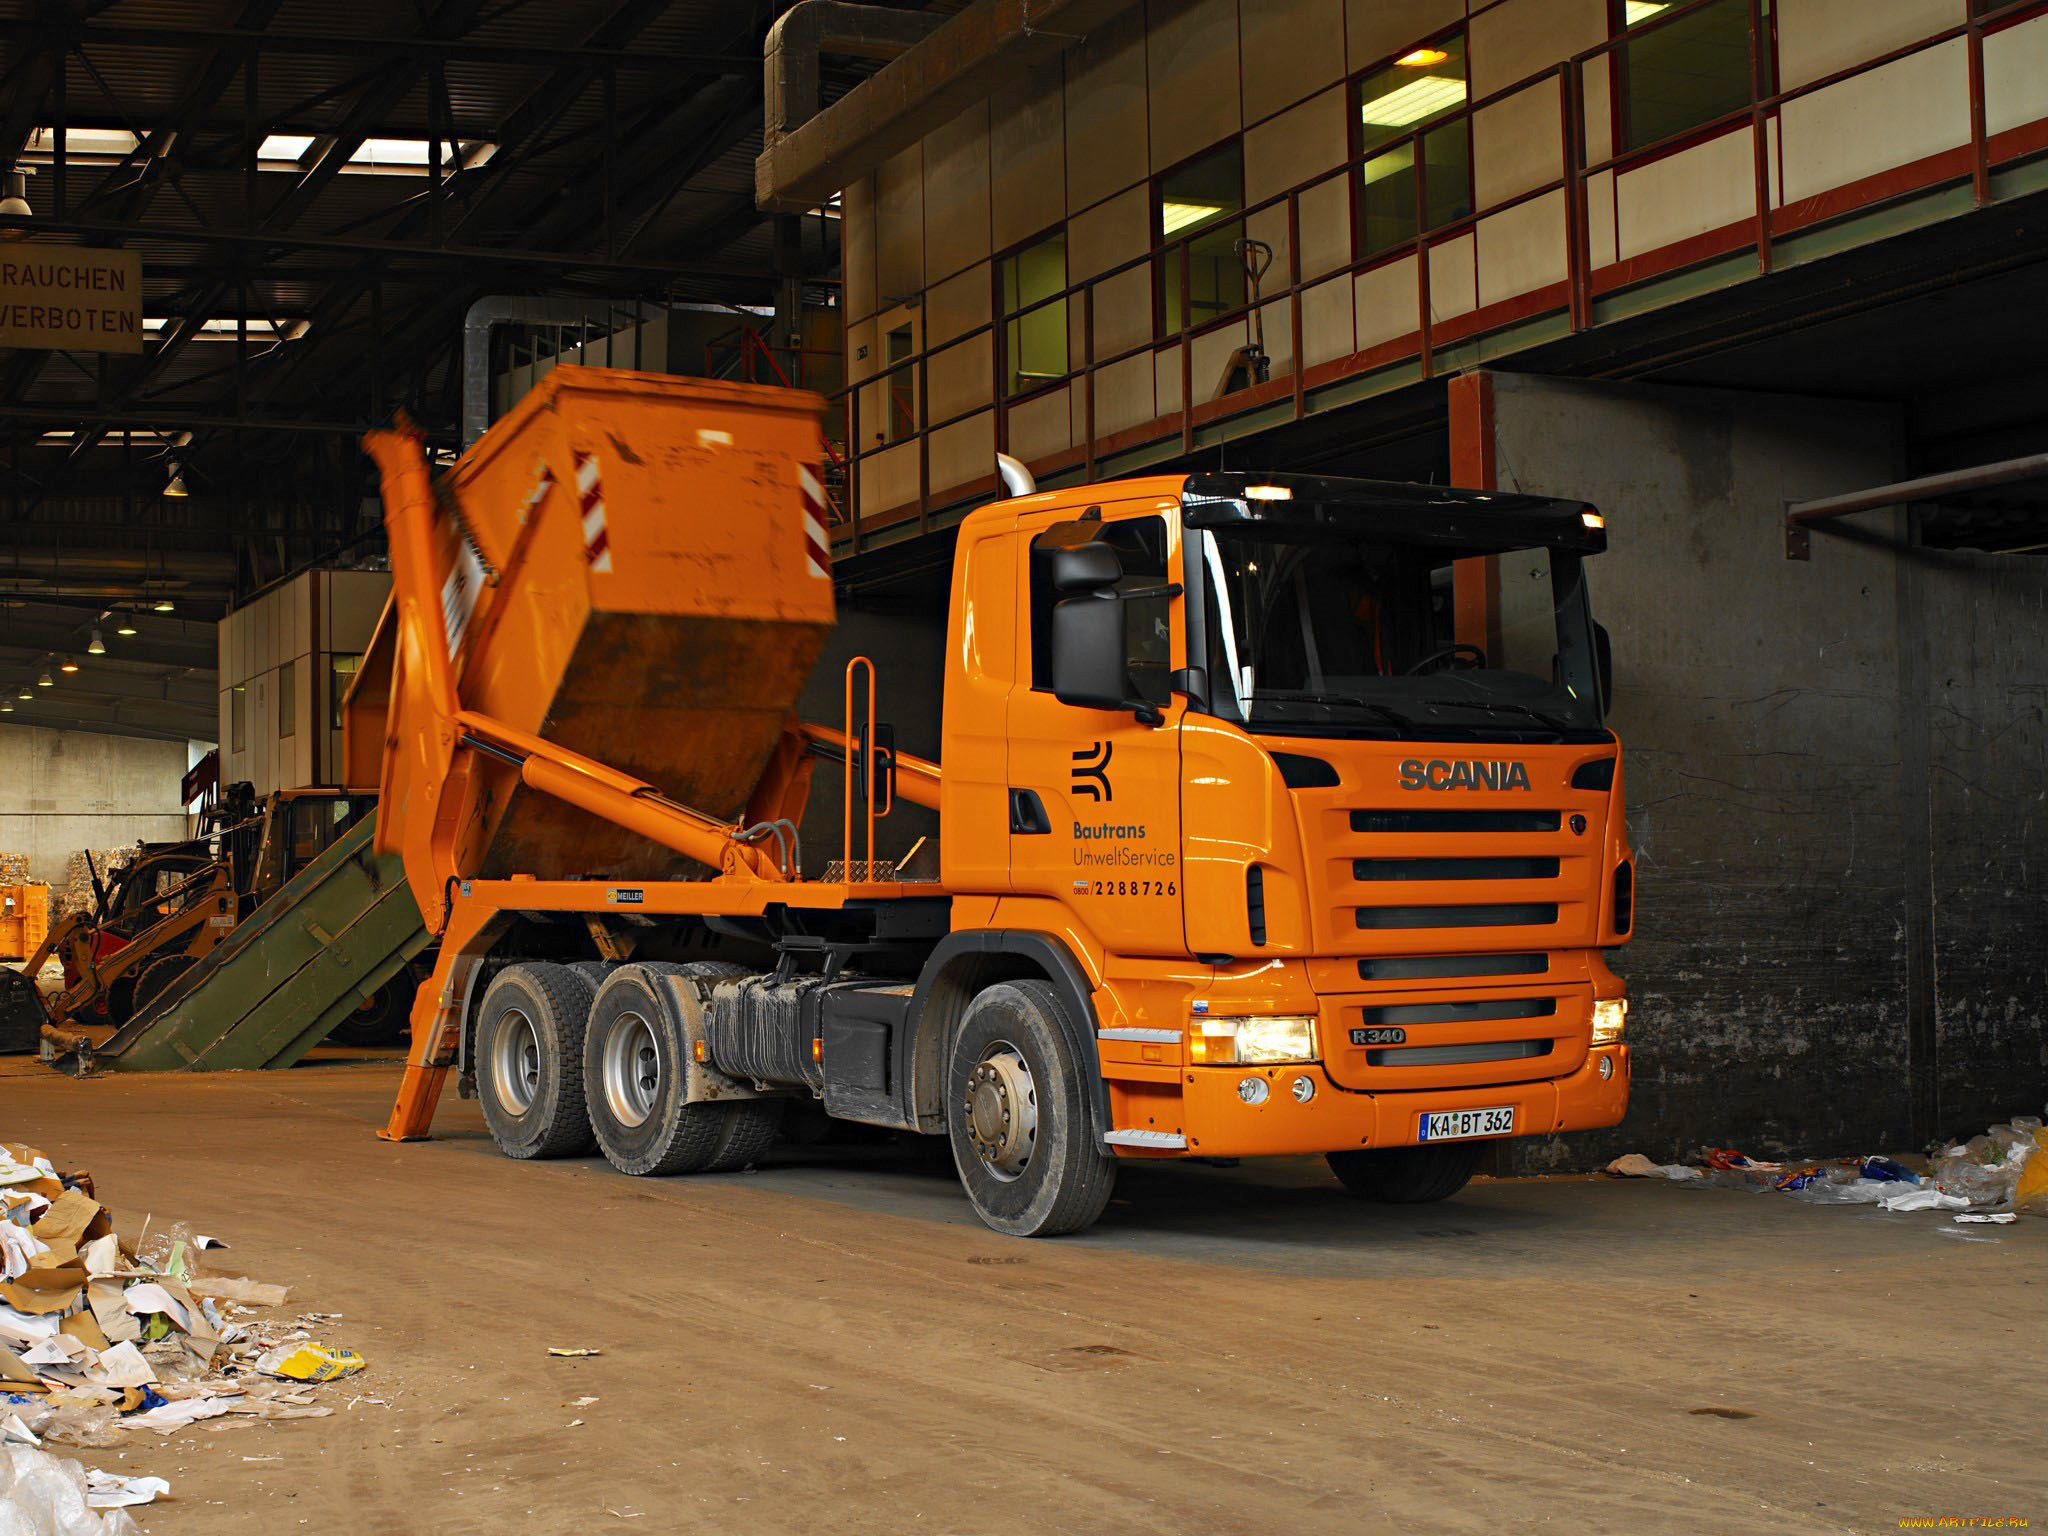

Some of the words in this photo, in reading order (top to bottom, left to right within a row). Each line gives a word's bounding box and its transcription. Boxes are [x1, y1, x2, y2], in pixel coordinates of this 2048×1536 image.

[2, 263, 125, 292] RAUCHEN
[1398, 759, 1531, 791] SCANIA
[1073, 821, 1146, 840] Bautrans
[1073, 846, 1175, 867] UmweltService
[617, 892, 643, 901] MEILLER
[1430, 1115, 1450, 1137] KA
[1461, 1112, 1481, 1134] BT
[1484, 1110, 1512, 1132] 362
